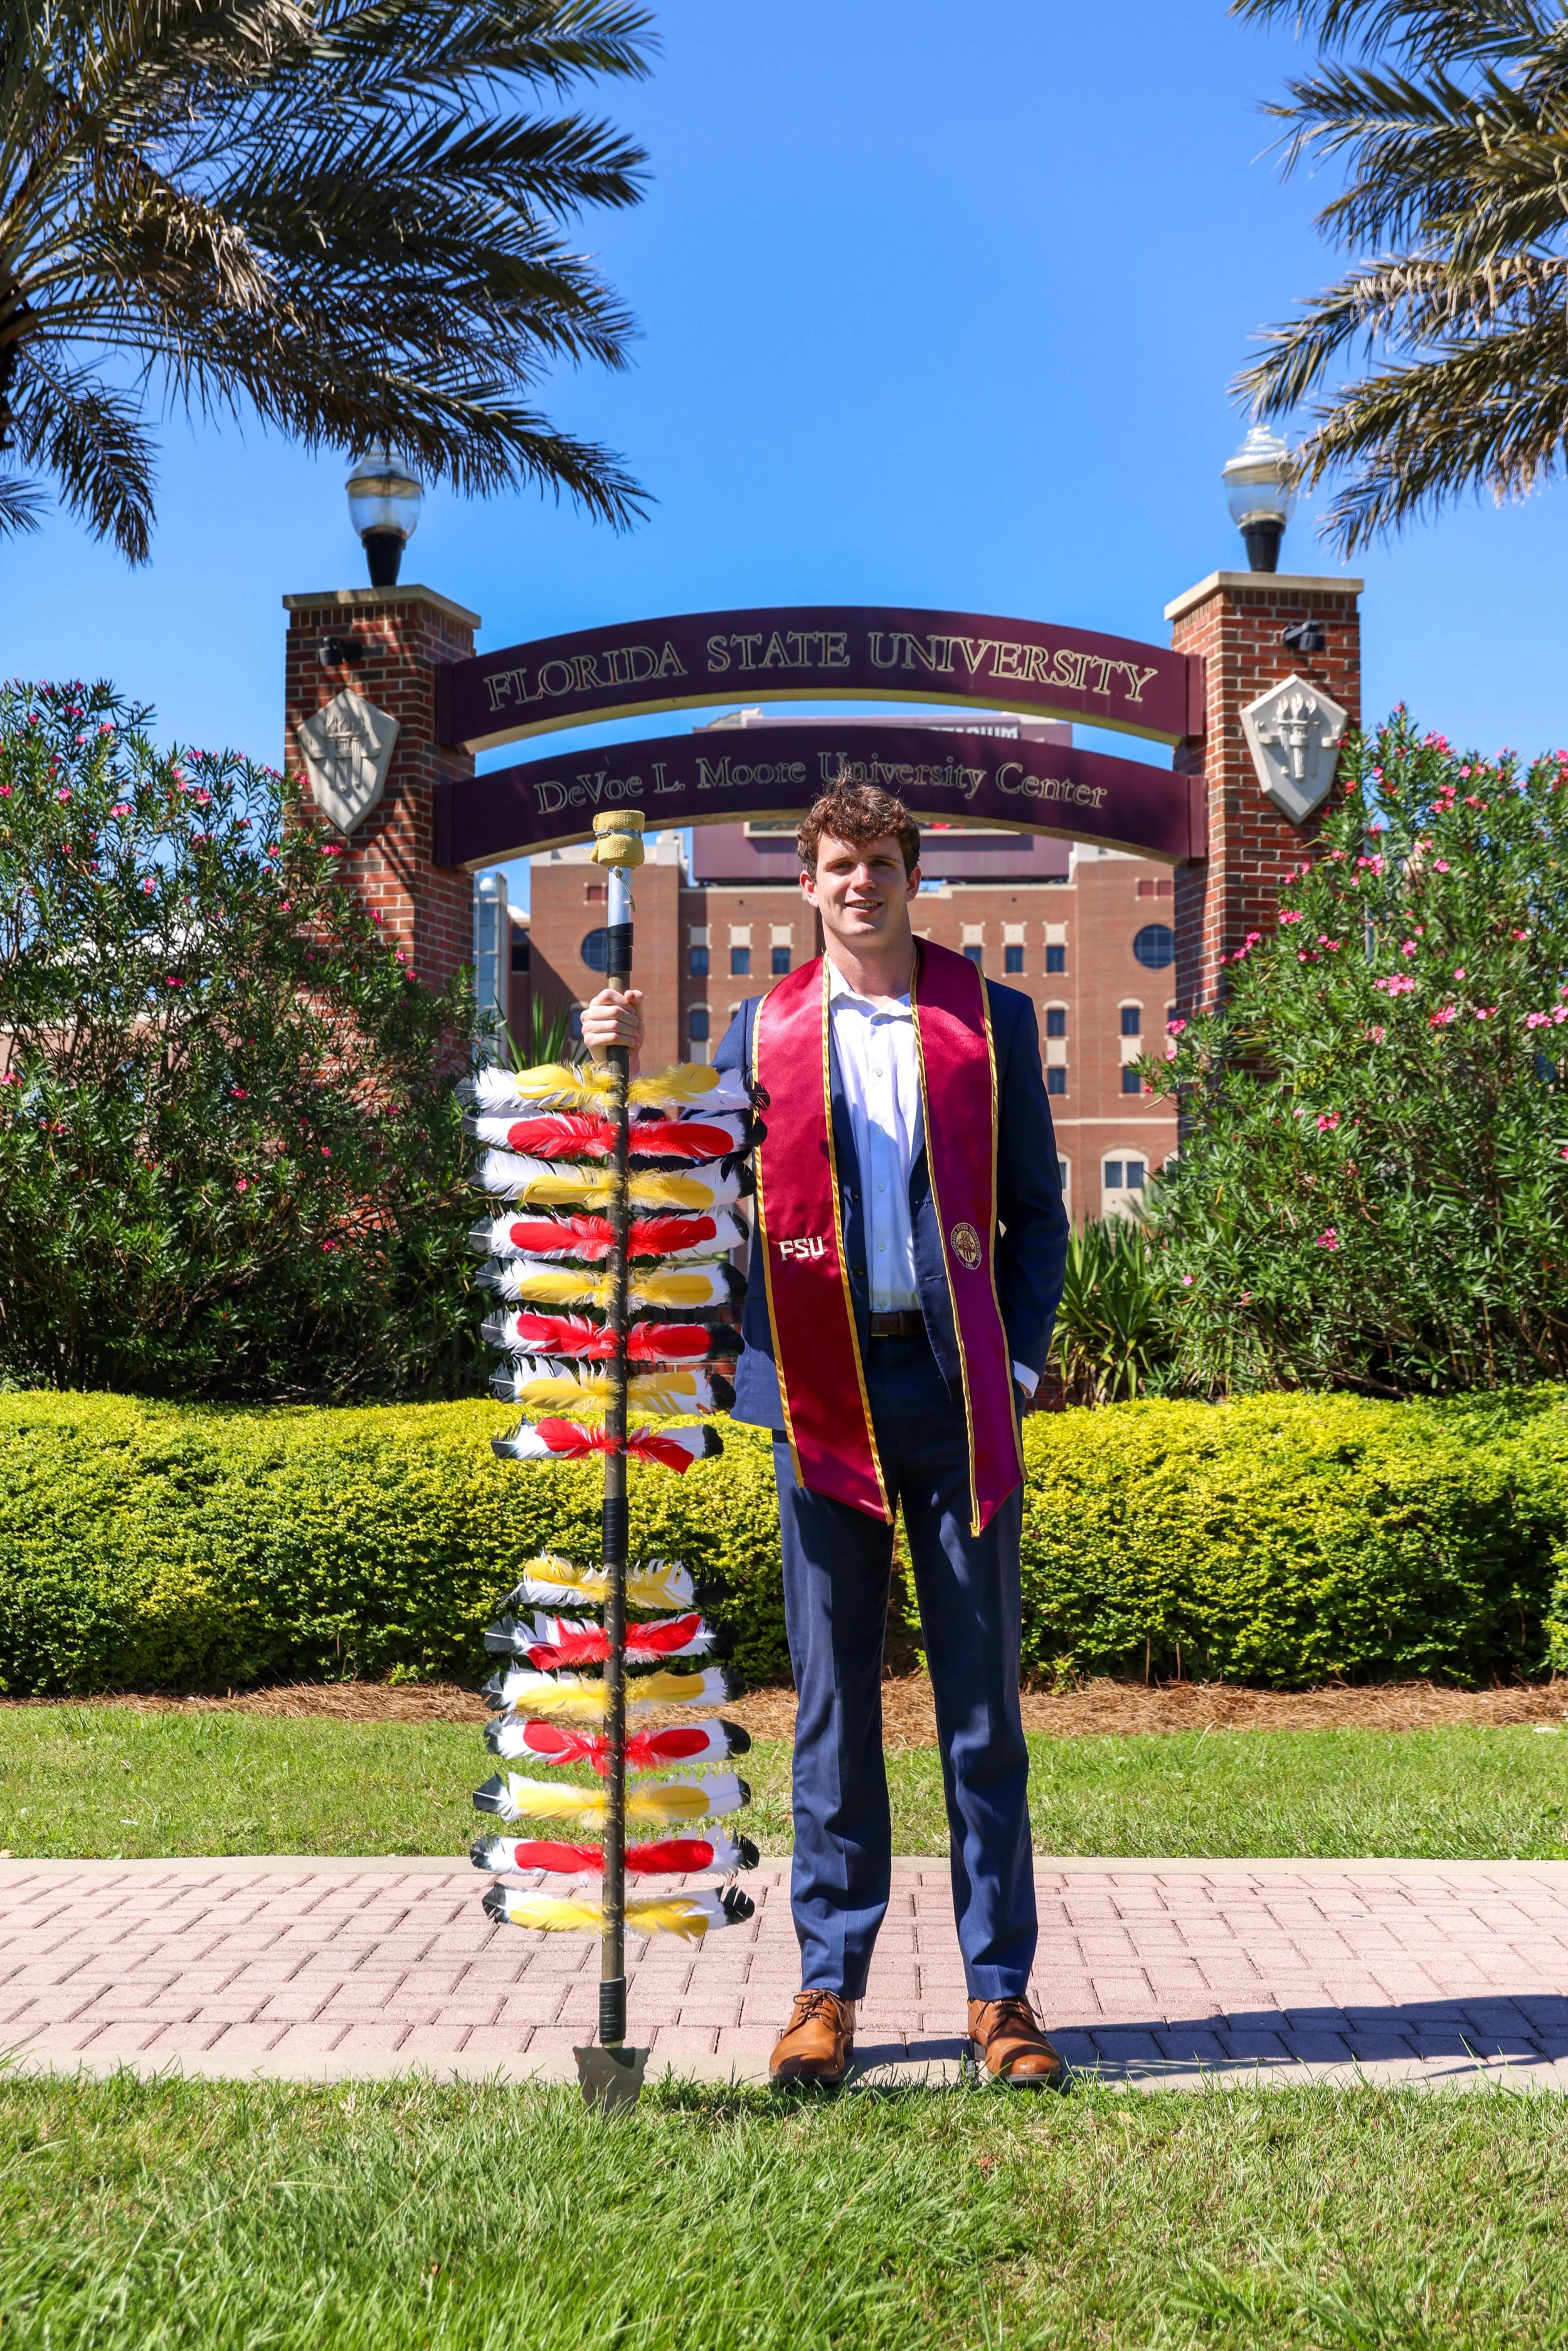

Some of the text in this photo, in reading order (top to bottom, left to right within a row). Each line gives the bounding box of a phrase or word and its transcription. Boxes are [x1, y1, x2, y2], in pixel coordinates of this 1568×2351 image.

[483, 632, 1158, 711] FLORIDA STATE UNIVERSITY
[534, 752, 1108, 814] DeVoe L. Moore University Center
[778, 1236, 825, 1261] FSU
